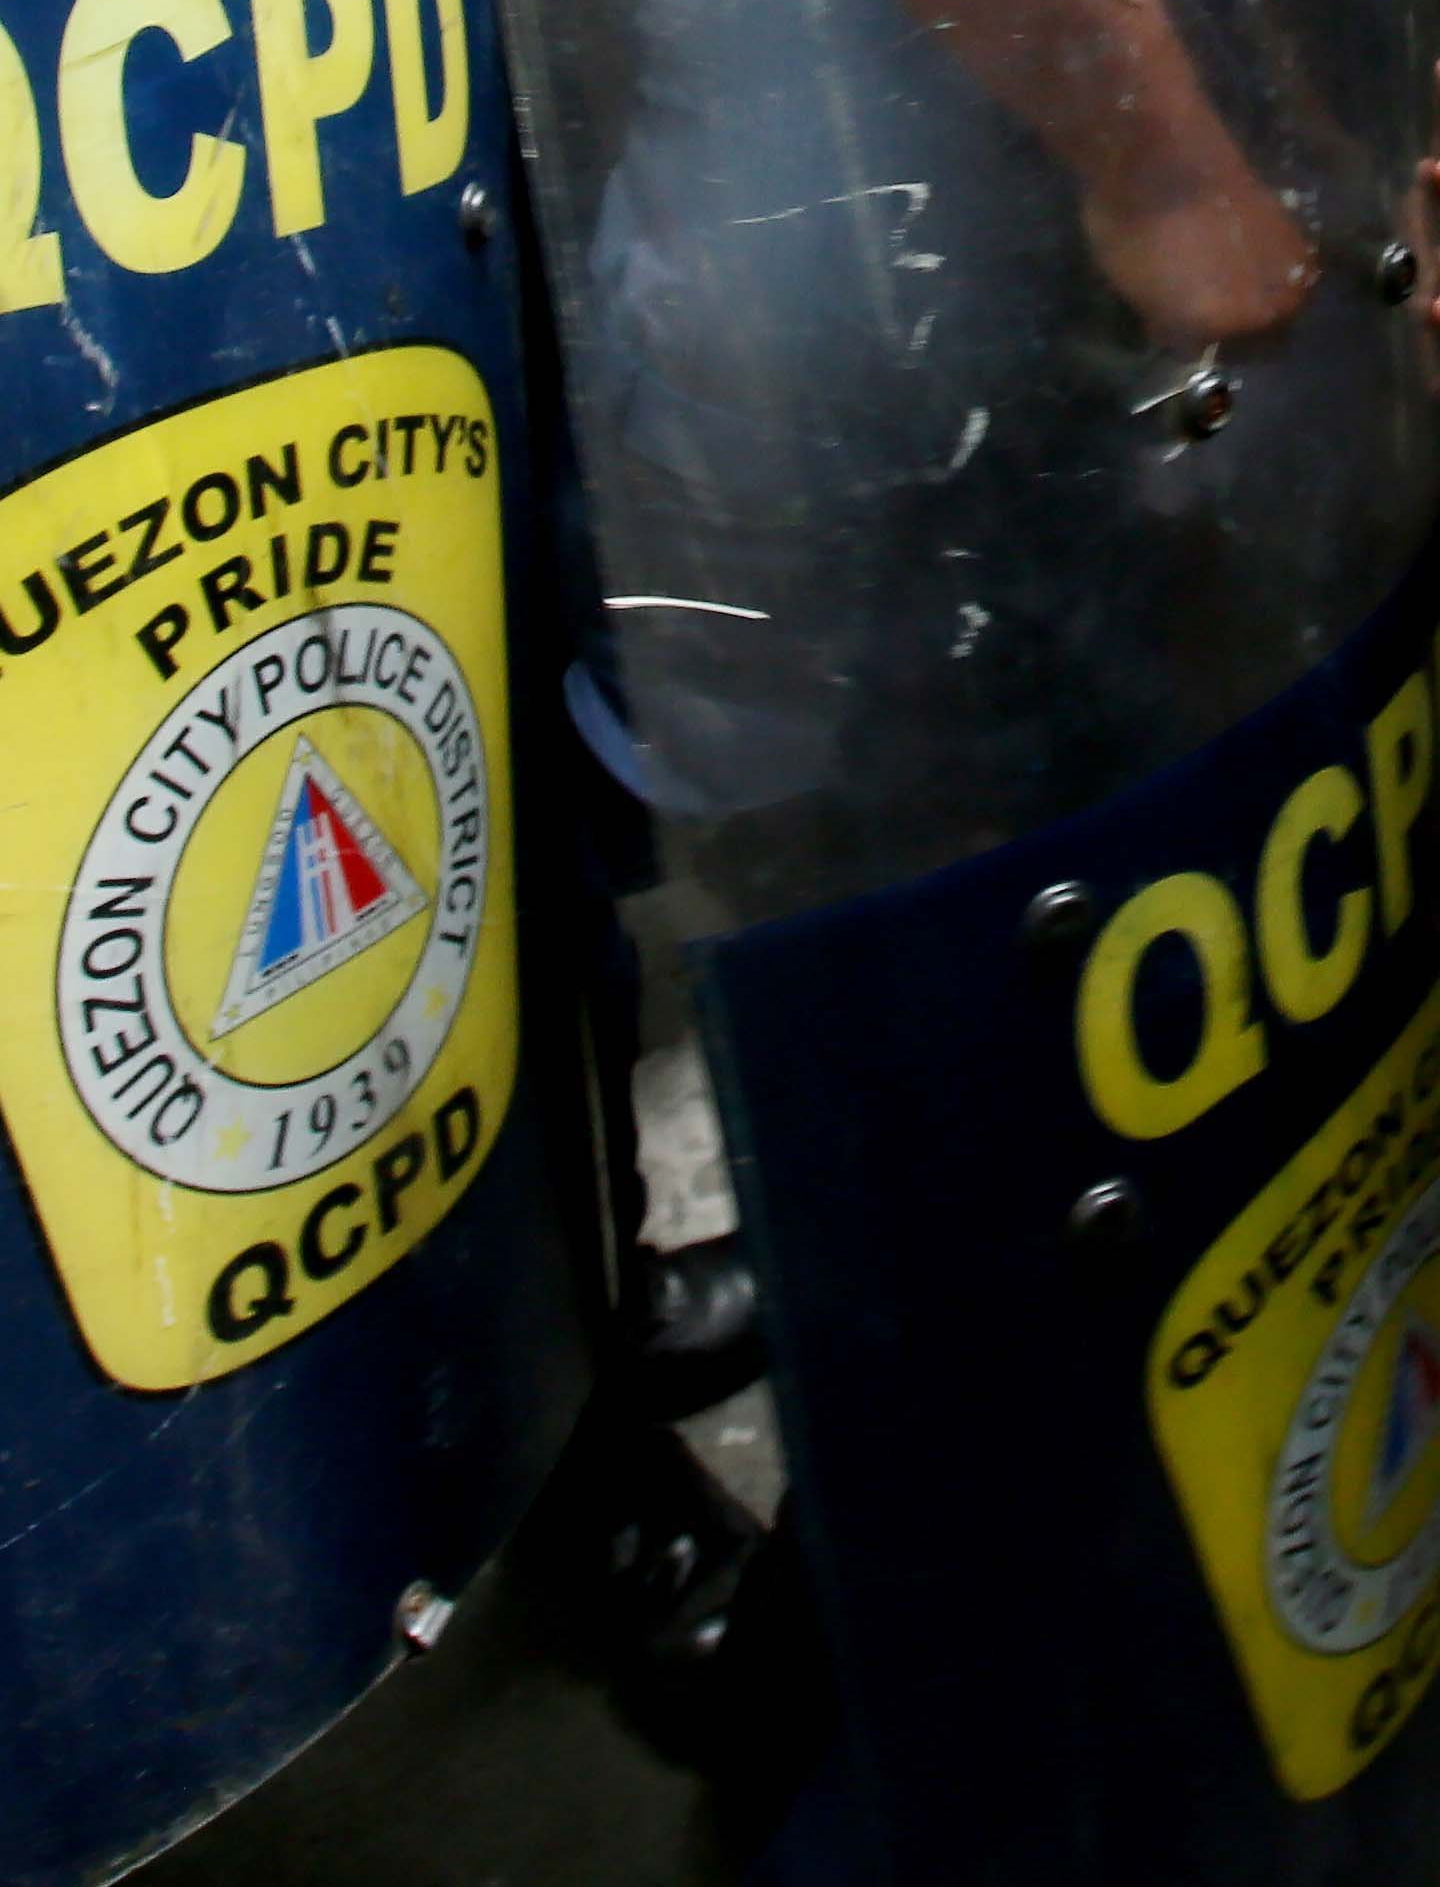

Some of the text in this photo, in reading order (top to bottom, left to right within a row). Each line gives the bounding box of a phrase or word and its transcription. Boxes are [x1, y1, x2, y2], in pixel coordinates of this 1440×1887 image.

[327, 413, 487, 488] CITY'S
[134, 519, 400, 683] PRIDE
[252, 628, 430, 716] POLICE
[123, 688, 240, 844] CITY
[426, 682, 480, 960] DISTRICT
[81, 874, 206, 1147] QUEZON
[268, 1037, 410, 1172] 1939
[207, 1086, 481, 1344] QCPD
